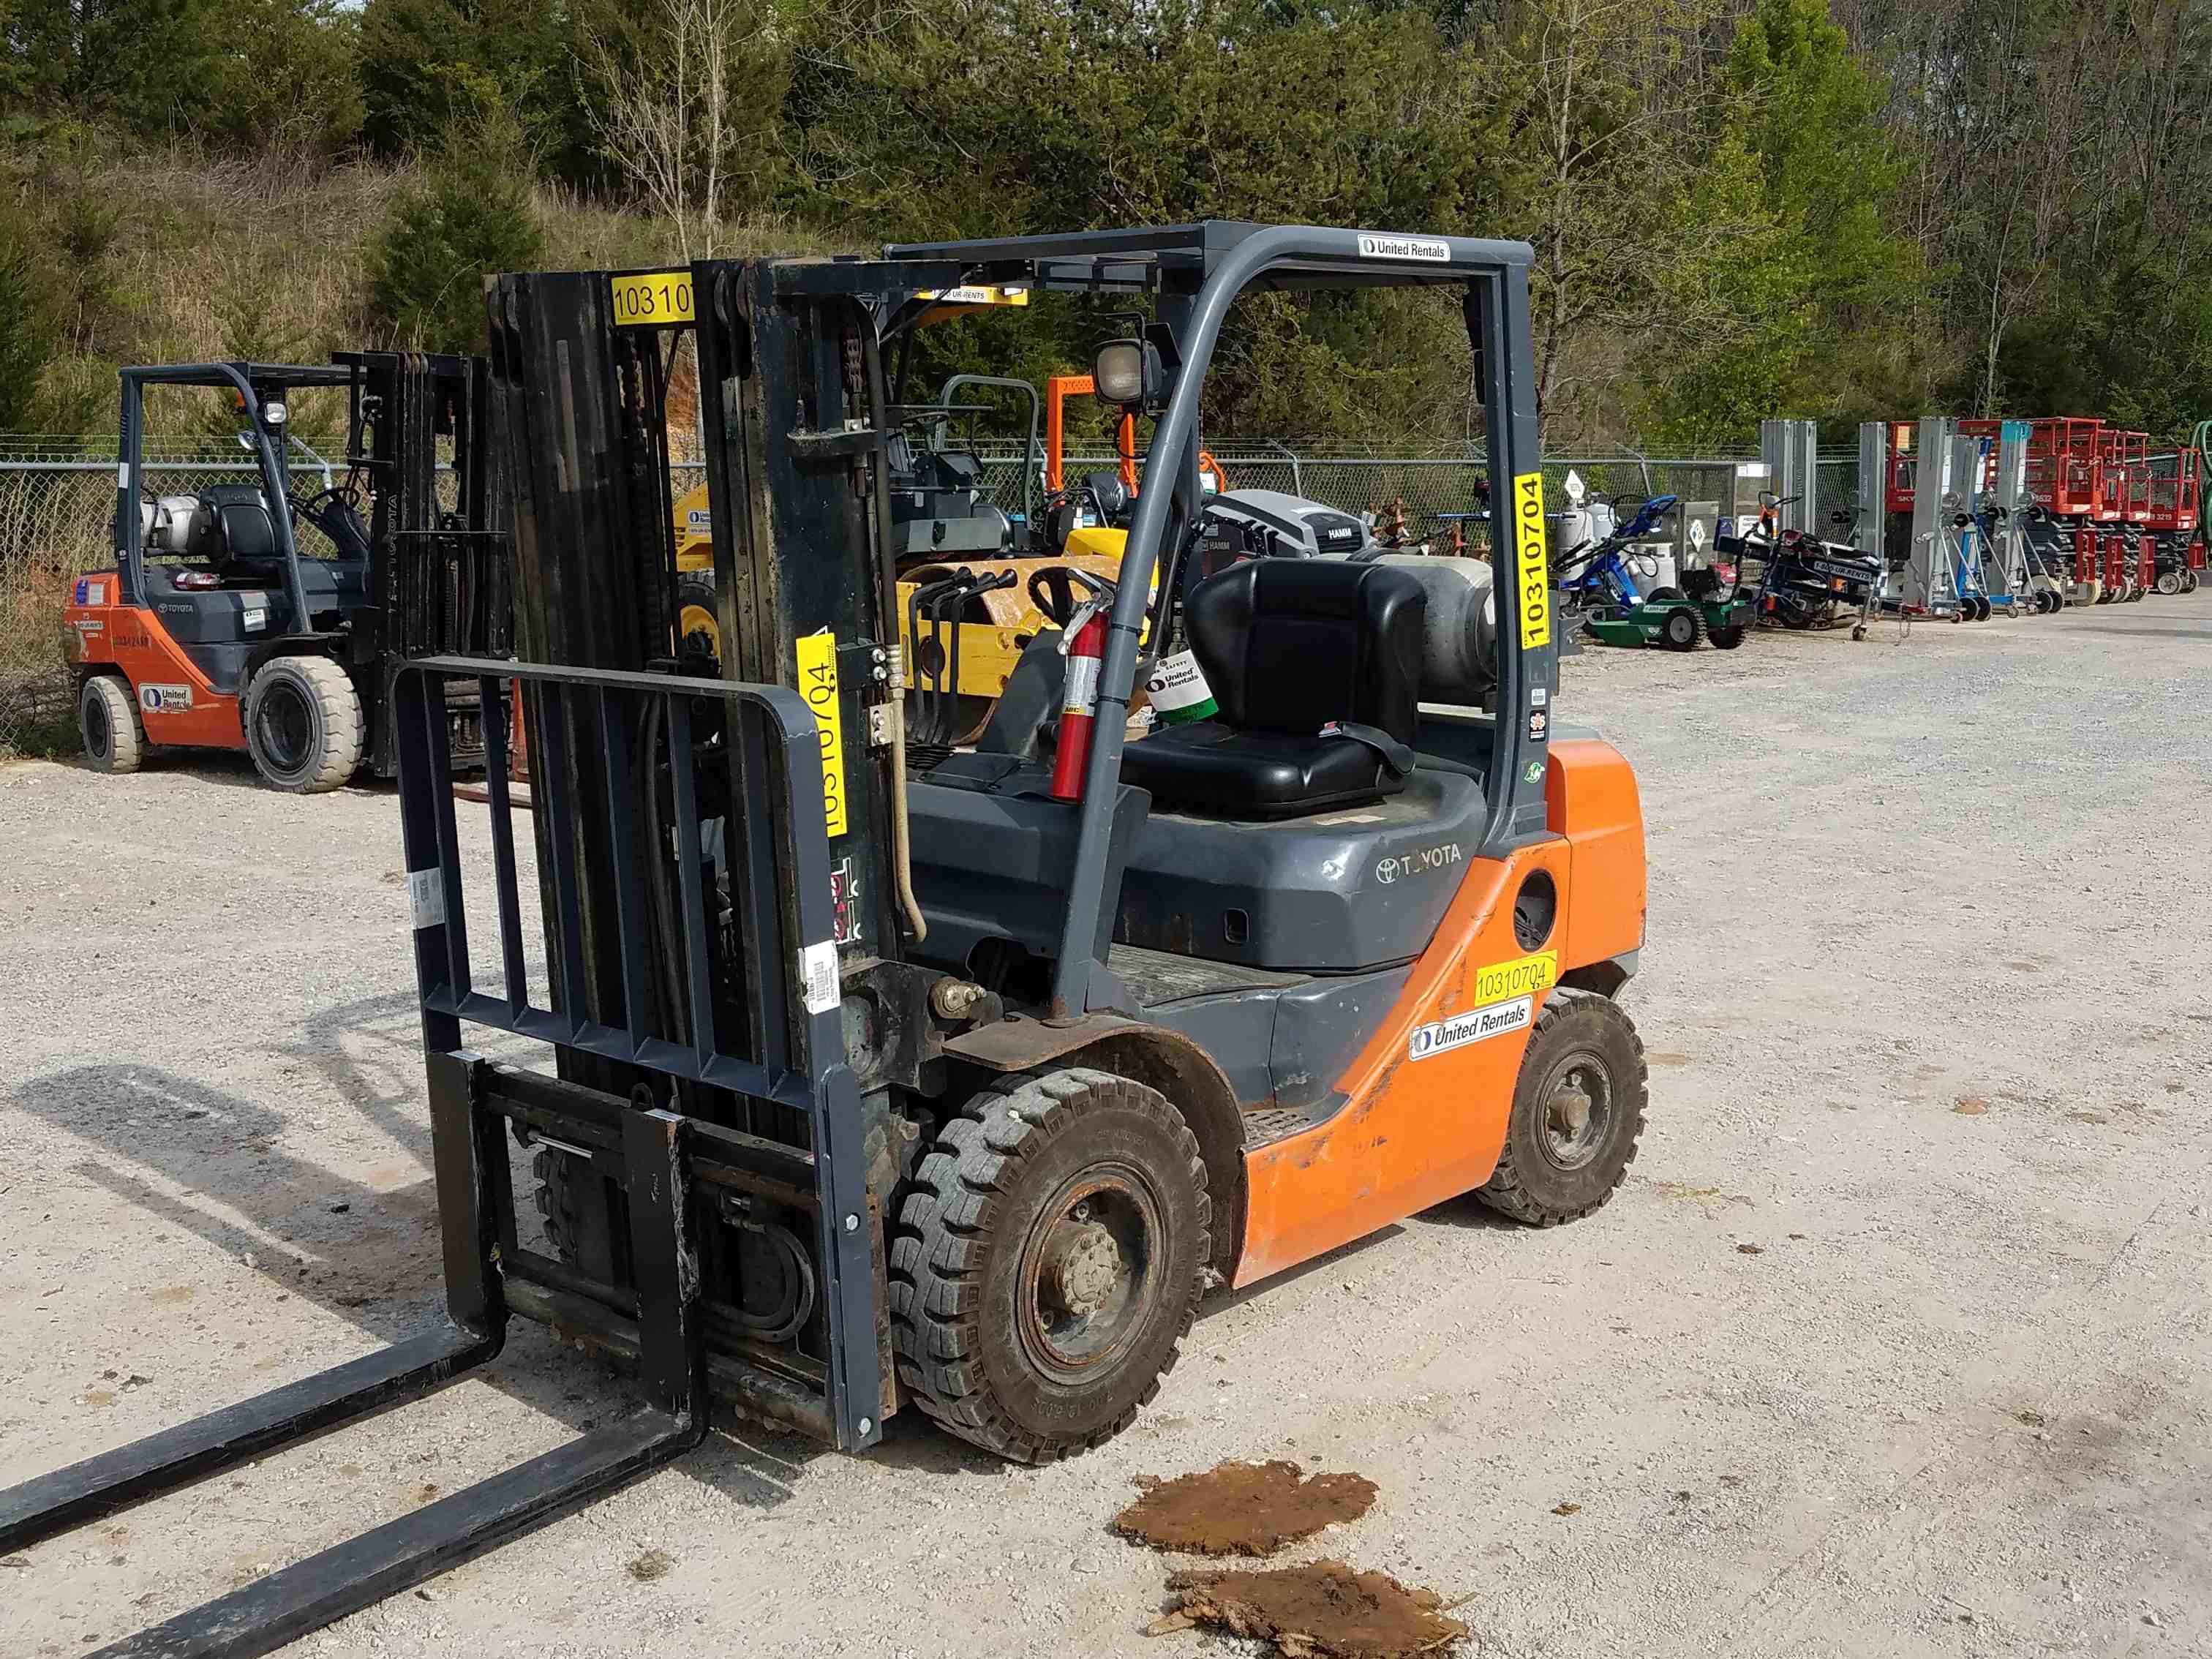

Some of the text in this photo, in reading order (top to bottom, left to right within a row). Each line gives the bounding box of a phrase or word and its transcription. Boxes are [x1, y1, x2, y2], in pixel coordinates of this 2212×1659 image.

[1378, 241, 1445, 257] United Rentals
[615, 284, 694, 316] 10310
[1328, 527, 1352, 540] HAMM
[1208, 541, 1230, 550] HAMM
[1521, 478, 1545, 642] 10310704
[168, 604, 194, 614] TOYOTA
[1165, 666, 1194, 682] United
[1168, 674, 1199, 688] Rentals
[162, 690, 187, 699] United
[1399, 843, 1462, 875] TYOTA
[1478, 961, 1546, 998] 10310704
[1435, 1004, 1527, 1046] United Rentals
